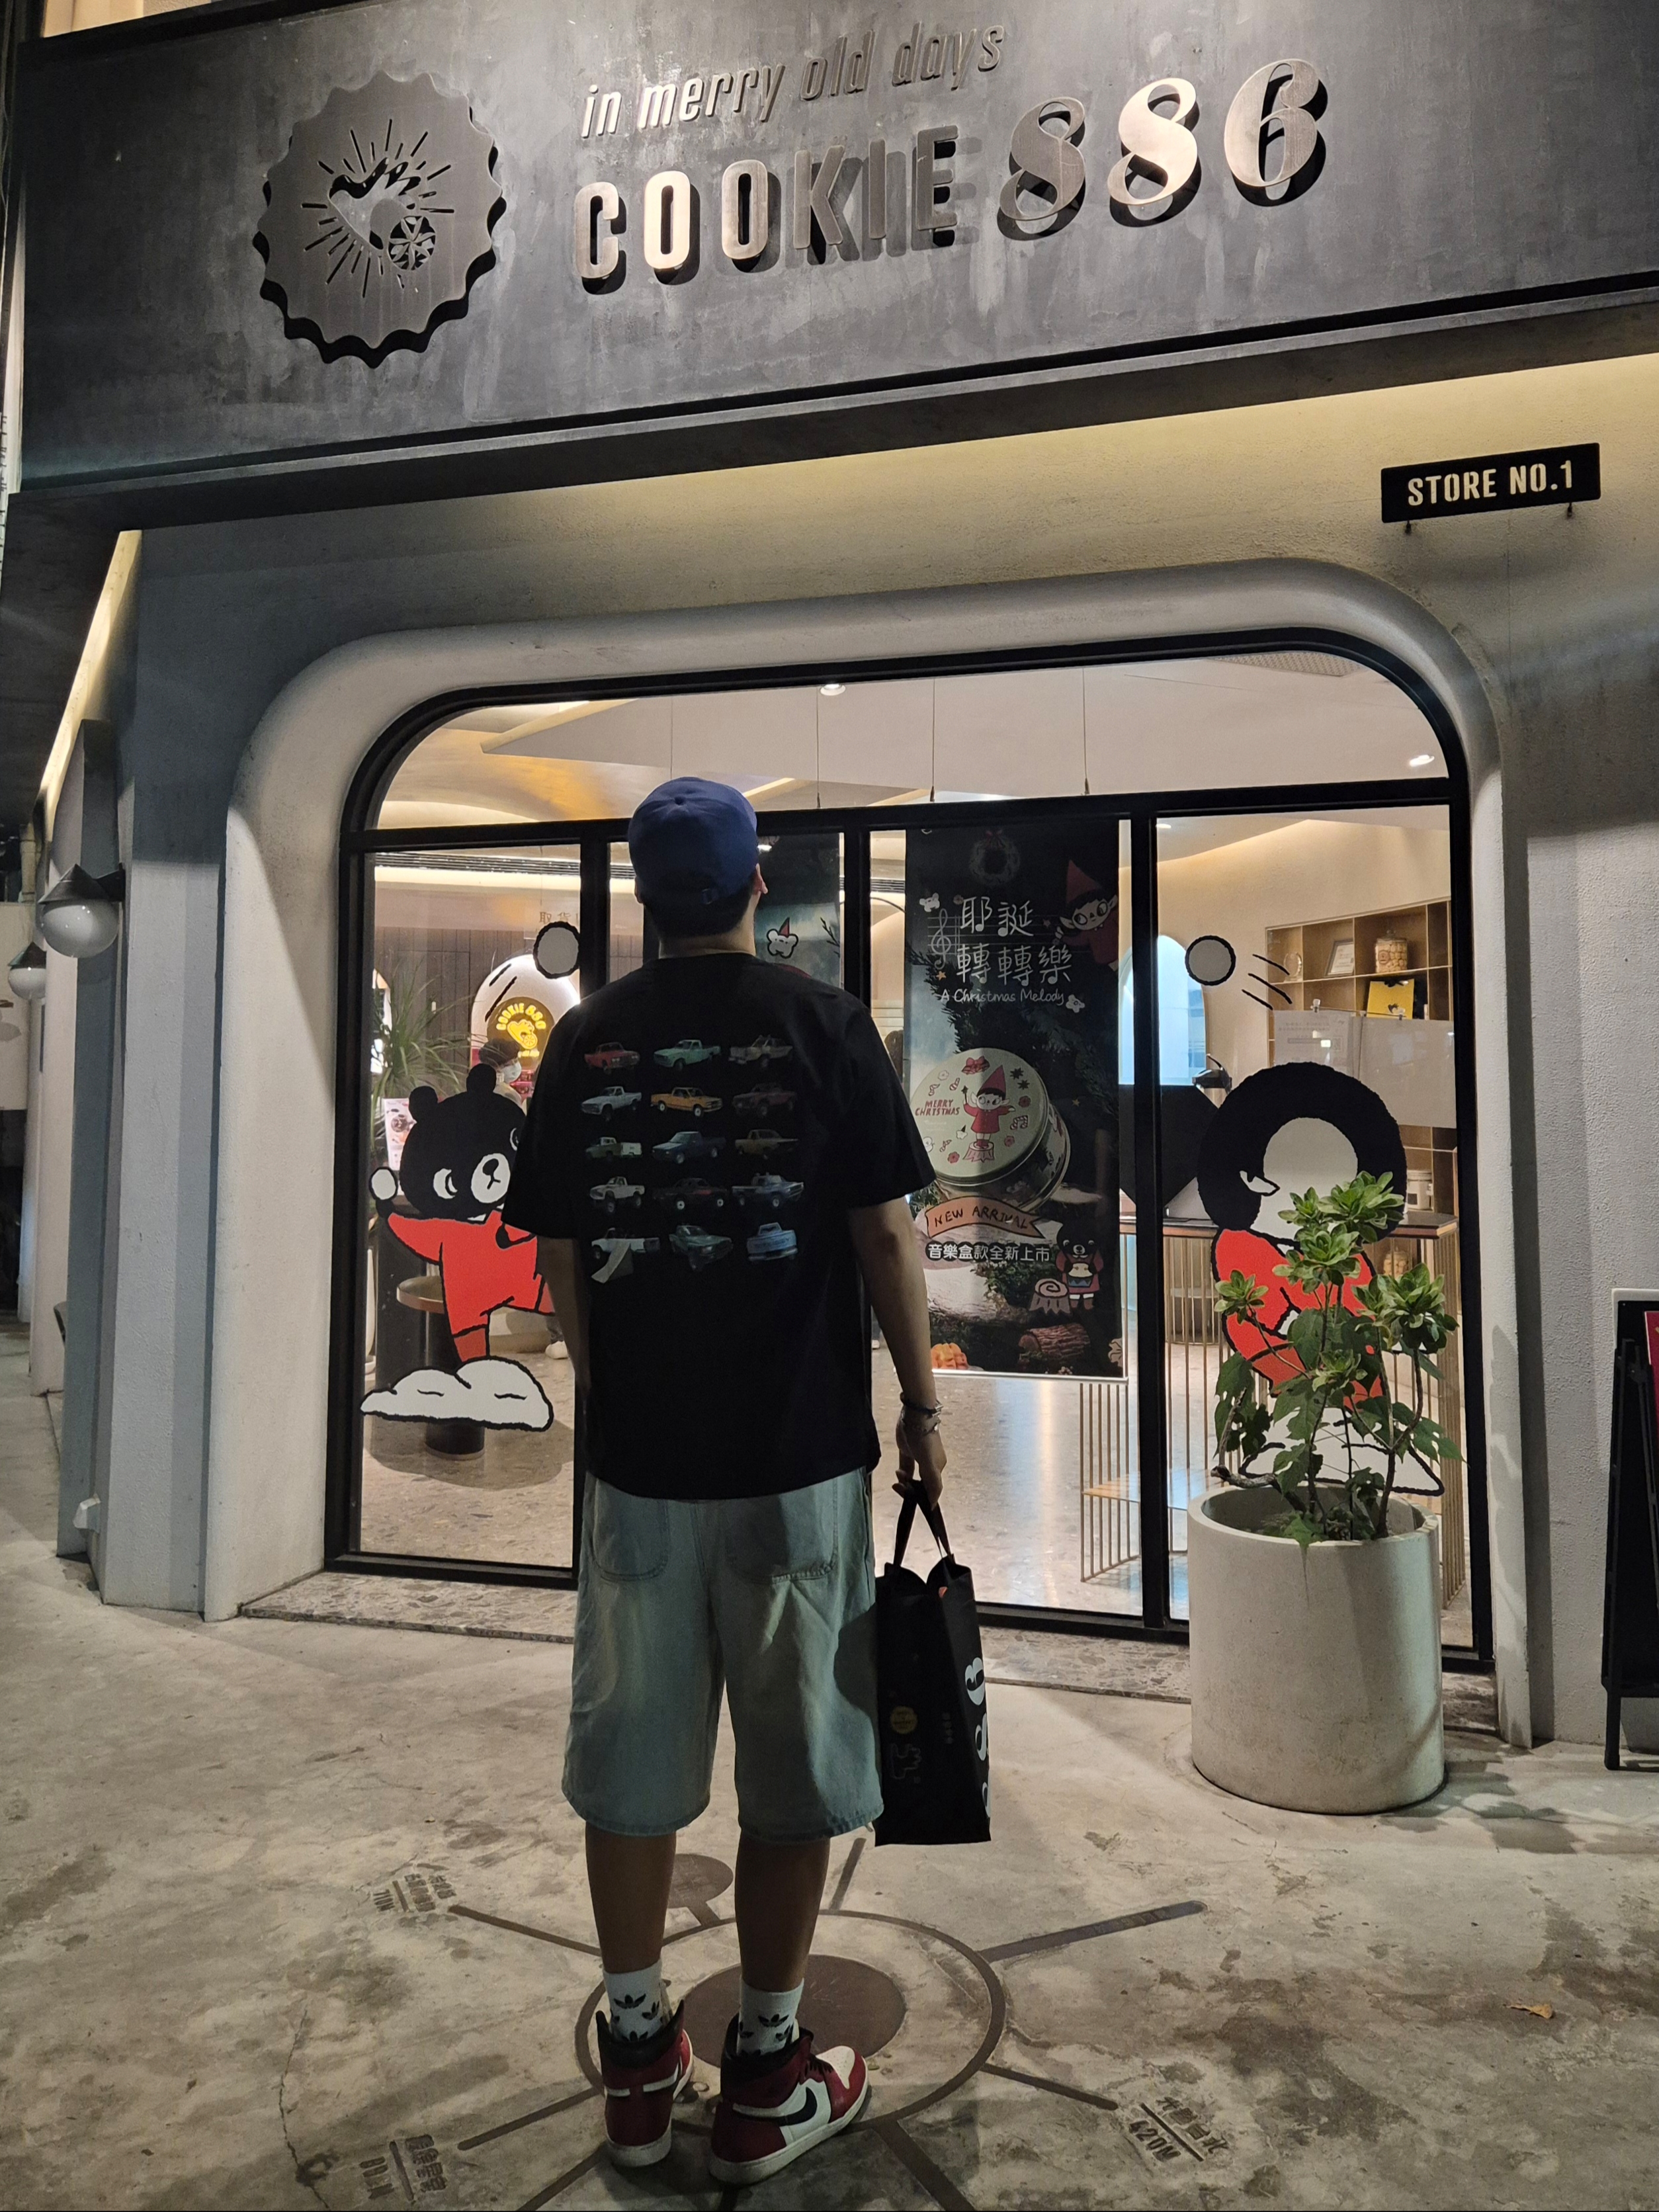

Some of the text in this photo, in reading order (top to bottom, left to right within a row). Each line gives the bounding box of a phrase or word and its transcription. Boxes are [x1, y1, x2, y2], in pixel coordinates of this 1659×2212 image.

[582, 21, 1005, 139] in merry old days
[574, 58, 1320, 279] COOKIE 886
[1408, 460, 1572, 506] STORE NO.1
[960, 896, 1034, 937] 耶誕
[956, 943, 1072, 987] 轉轉樂
[940, 988, 1065, 1006] A Christmas Melody
[496, 1003, 525, 1030] COOKIE
[915, 1107, 960, 1116] CHRISTMAS
[925, 1099, 954, 1108] MERRY
[934, 1205, 1028, 1229] NEW ARRIVAL
[927, 1243, 1050, 1262] 音樂盒款全新上市
